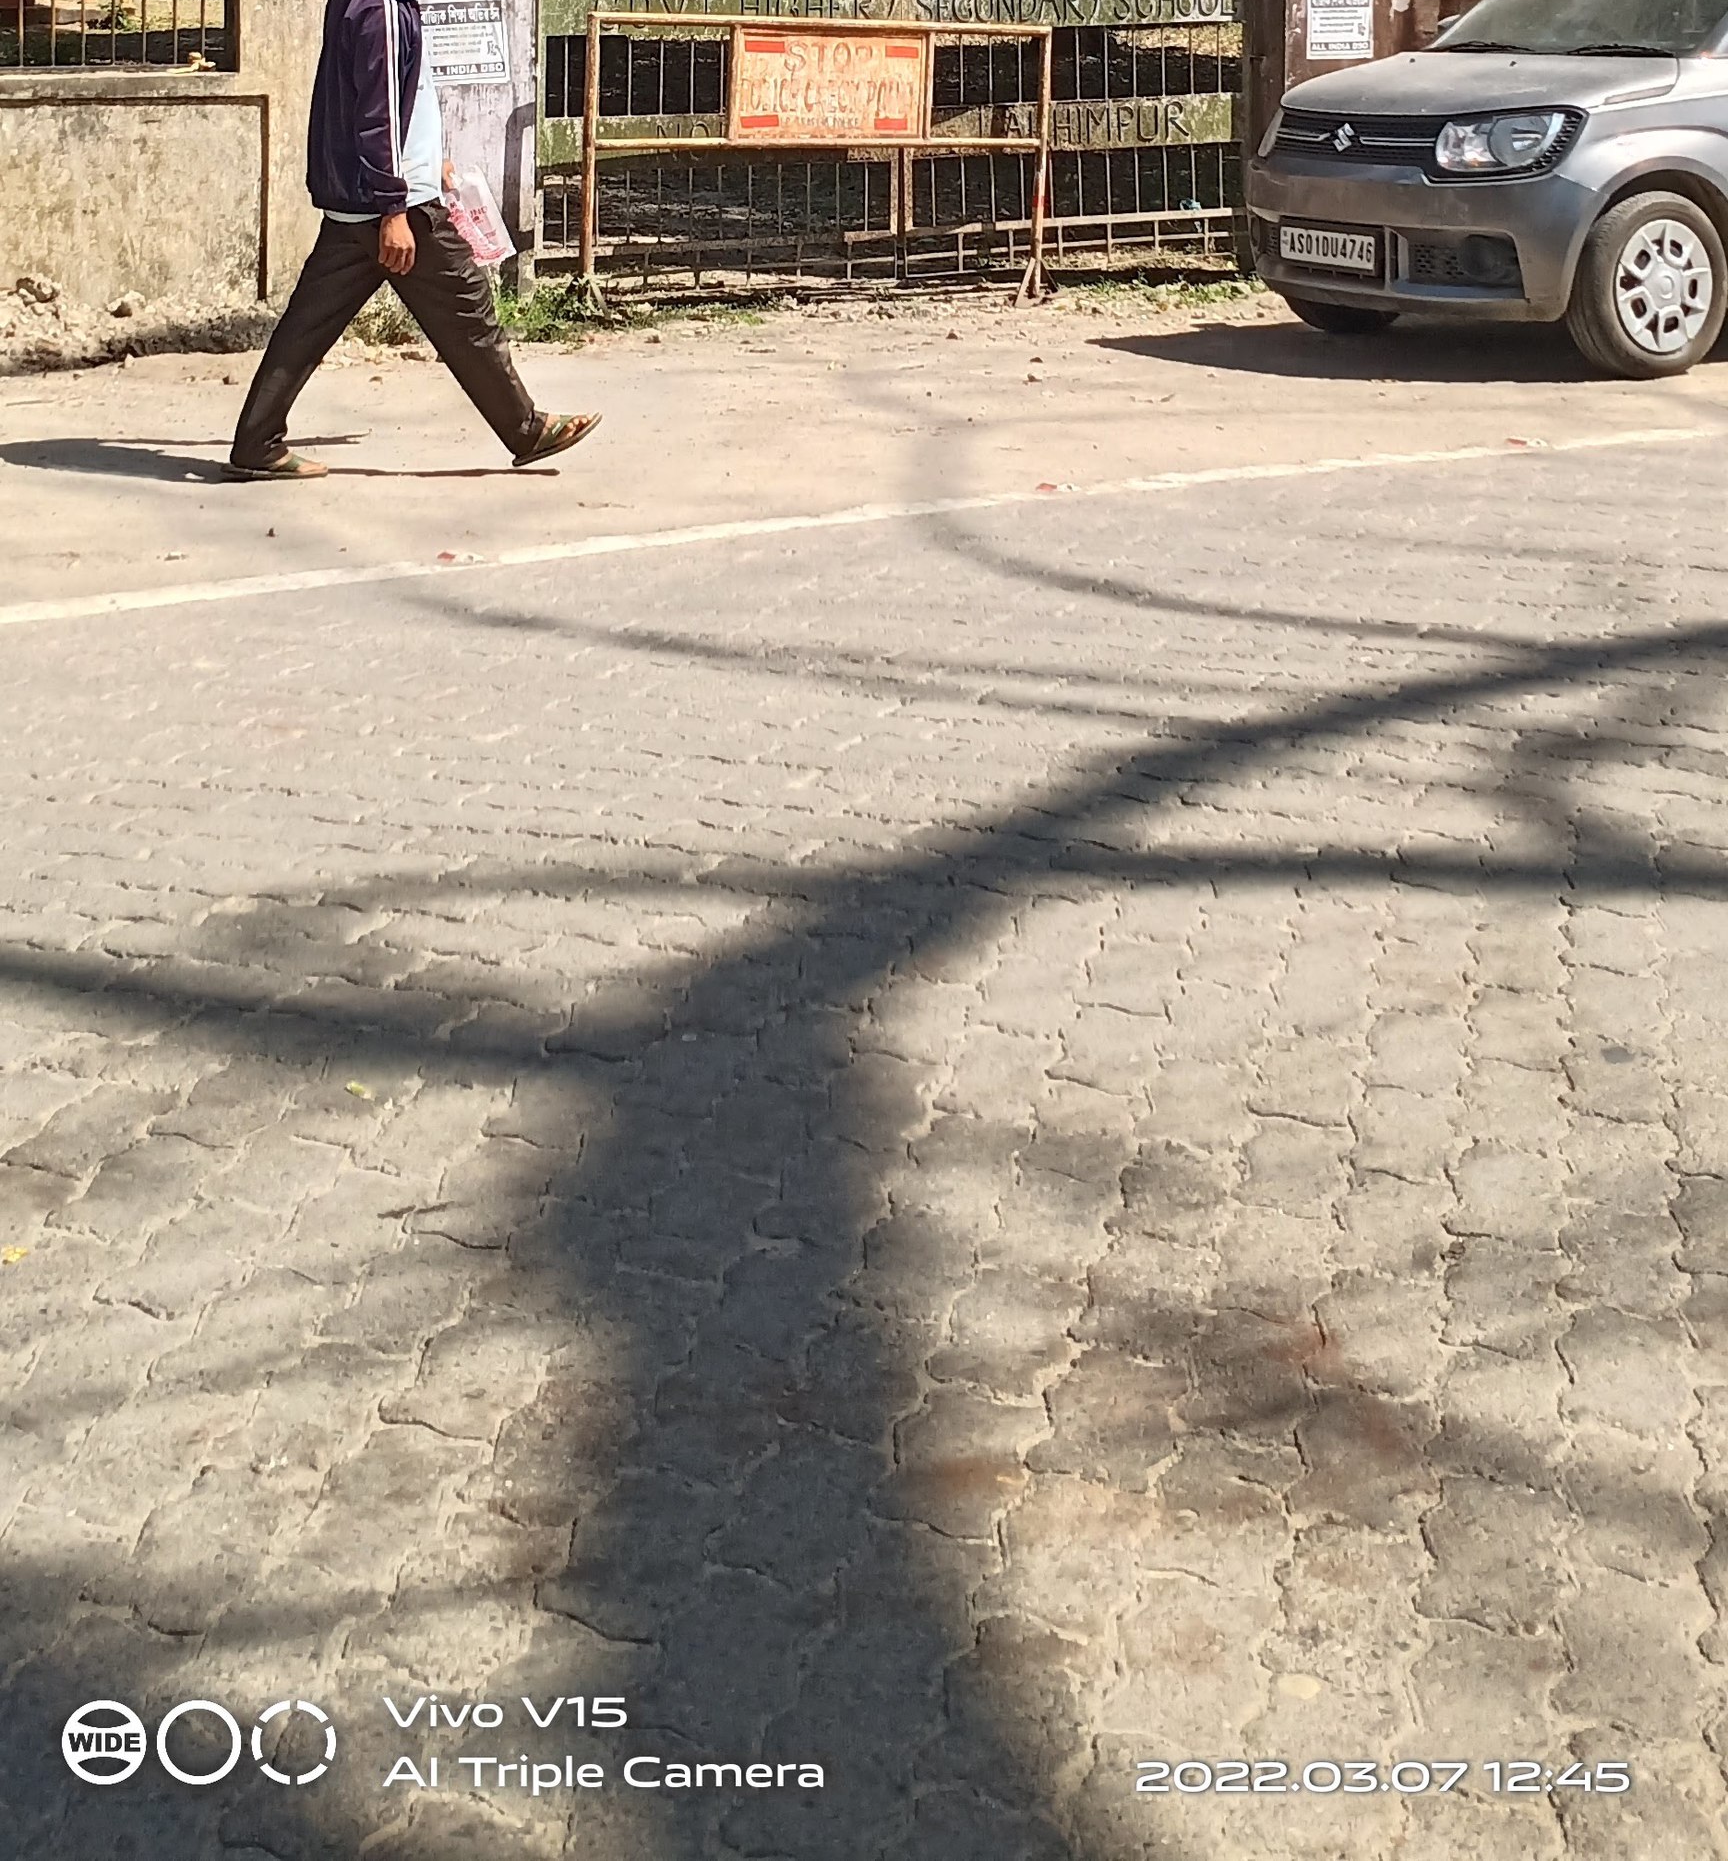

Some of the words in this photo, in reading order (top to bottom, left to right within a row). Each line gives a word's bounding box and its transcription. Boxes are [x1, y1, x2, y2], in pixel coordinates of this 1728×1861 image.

[431, 67, 444, 76] LL
[446, 64, 478, 75] INDIA
[480, 62, 504, 74] DSO
[1289, 231, 1373, 263] AS01DU4746
